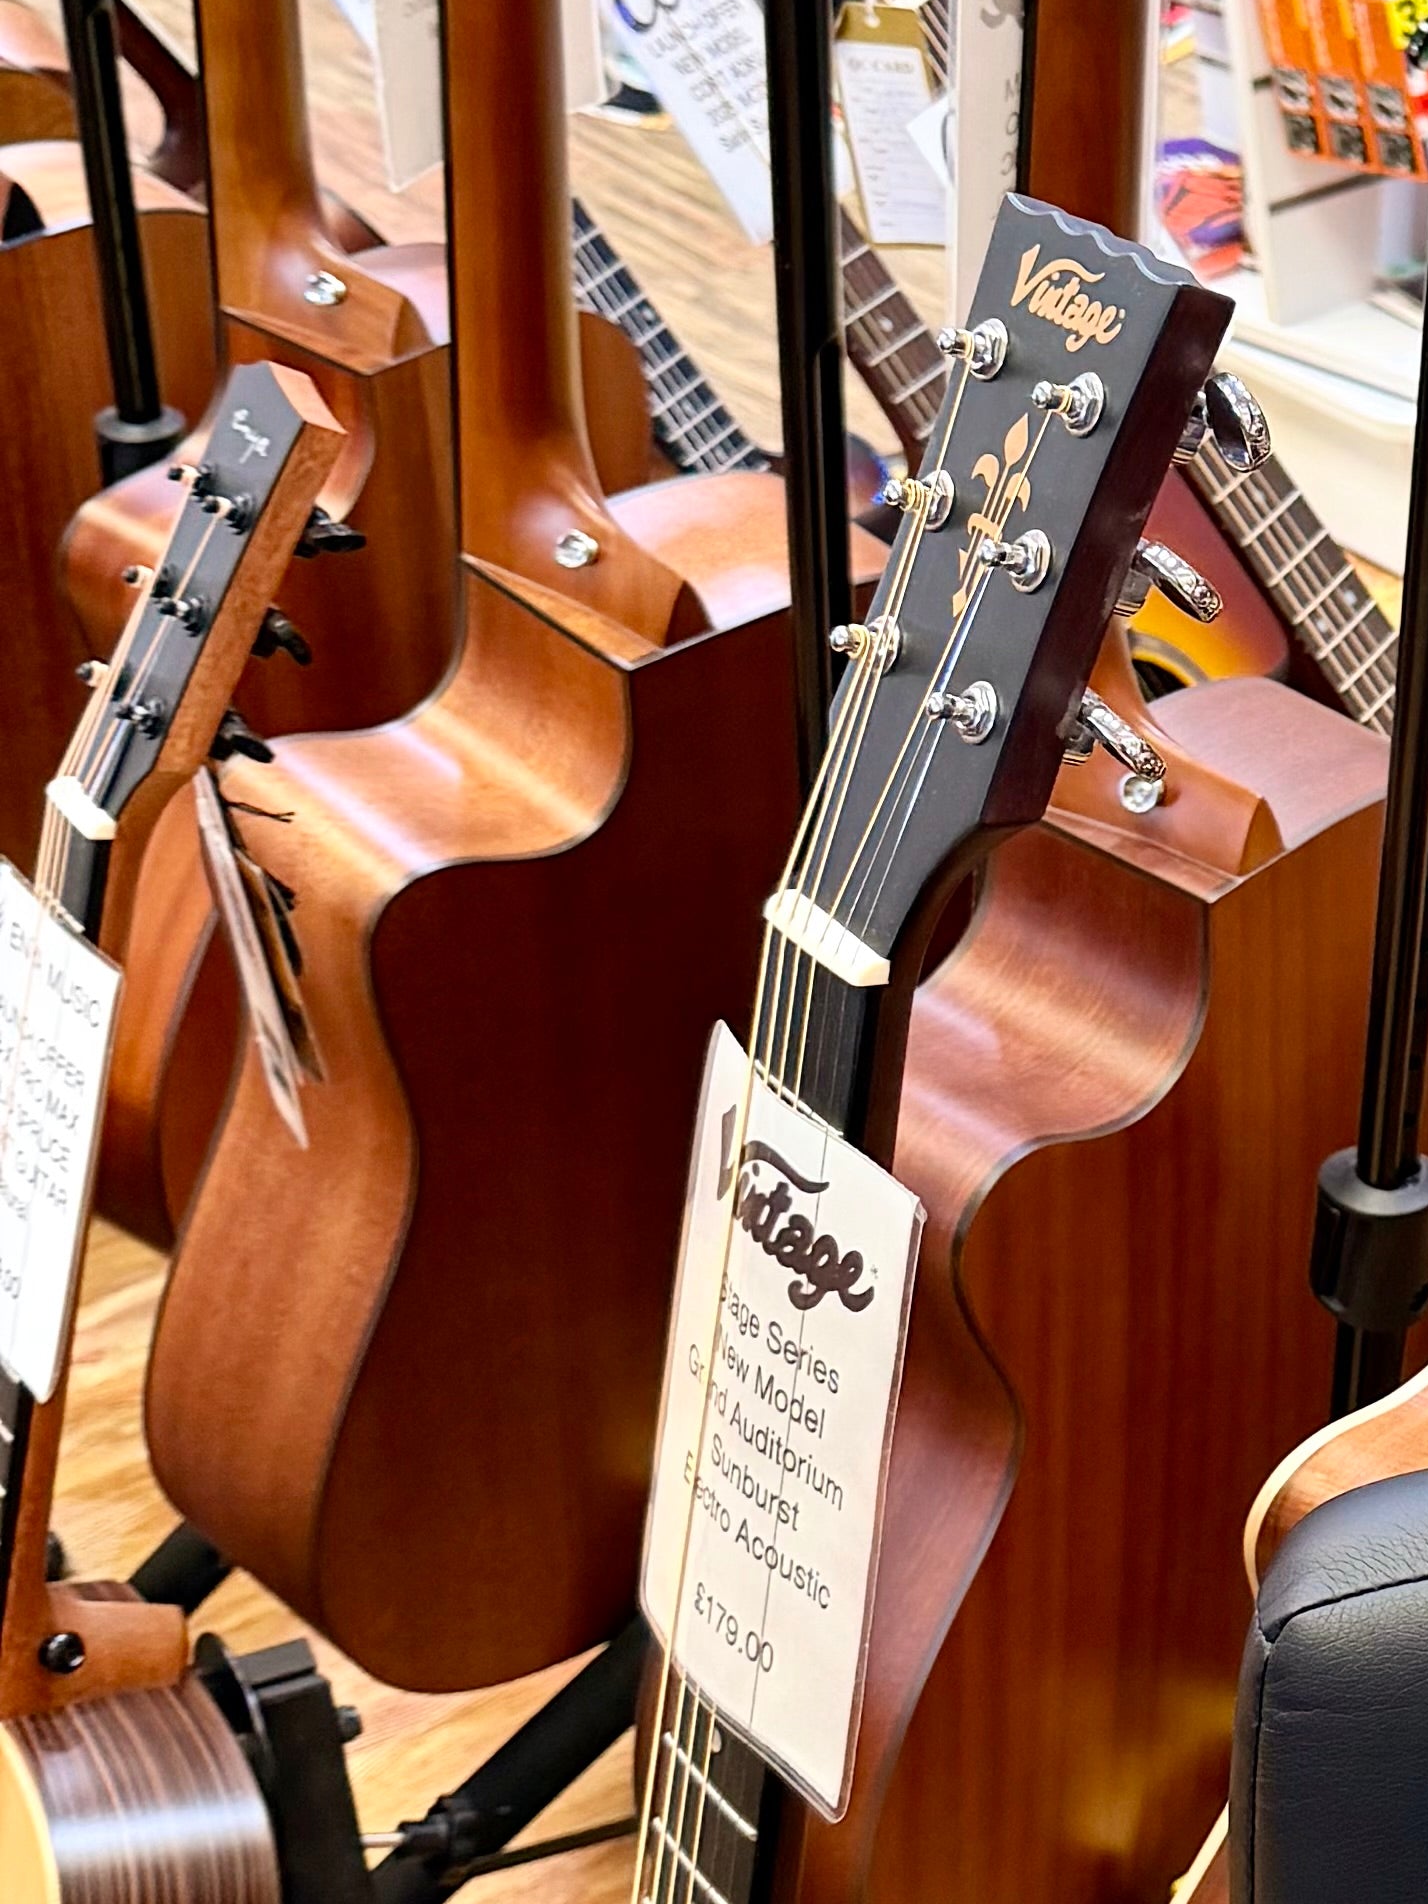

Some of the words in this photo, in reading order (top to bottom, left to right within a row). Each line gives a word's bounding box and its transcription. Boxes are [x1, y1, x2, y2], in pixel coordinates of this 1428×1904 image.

[1009, 243, 1127, 353] Vintage
[717, 1104, 875, 1312] Vintage
[754, 1366, 826, 1439] Model
[767, 1321, 840, 1394] Series
[689, 1344, 728, 1417] Grnd
[730, 1402, 843, 1511] Auditorium
[684, 1450, 731, 1533] Eectro
[735, 1518, 832, 1610] Acoustic
[711, 1433, 800, 1532] Sunburst
[694, 1582, 774, 1673] £179.00
